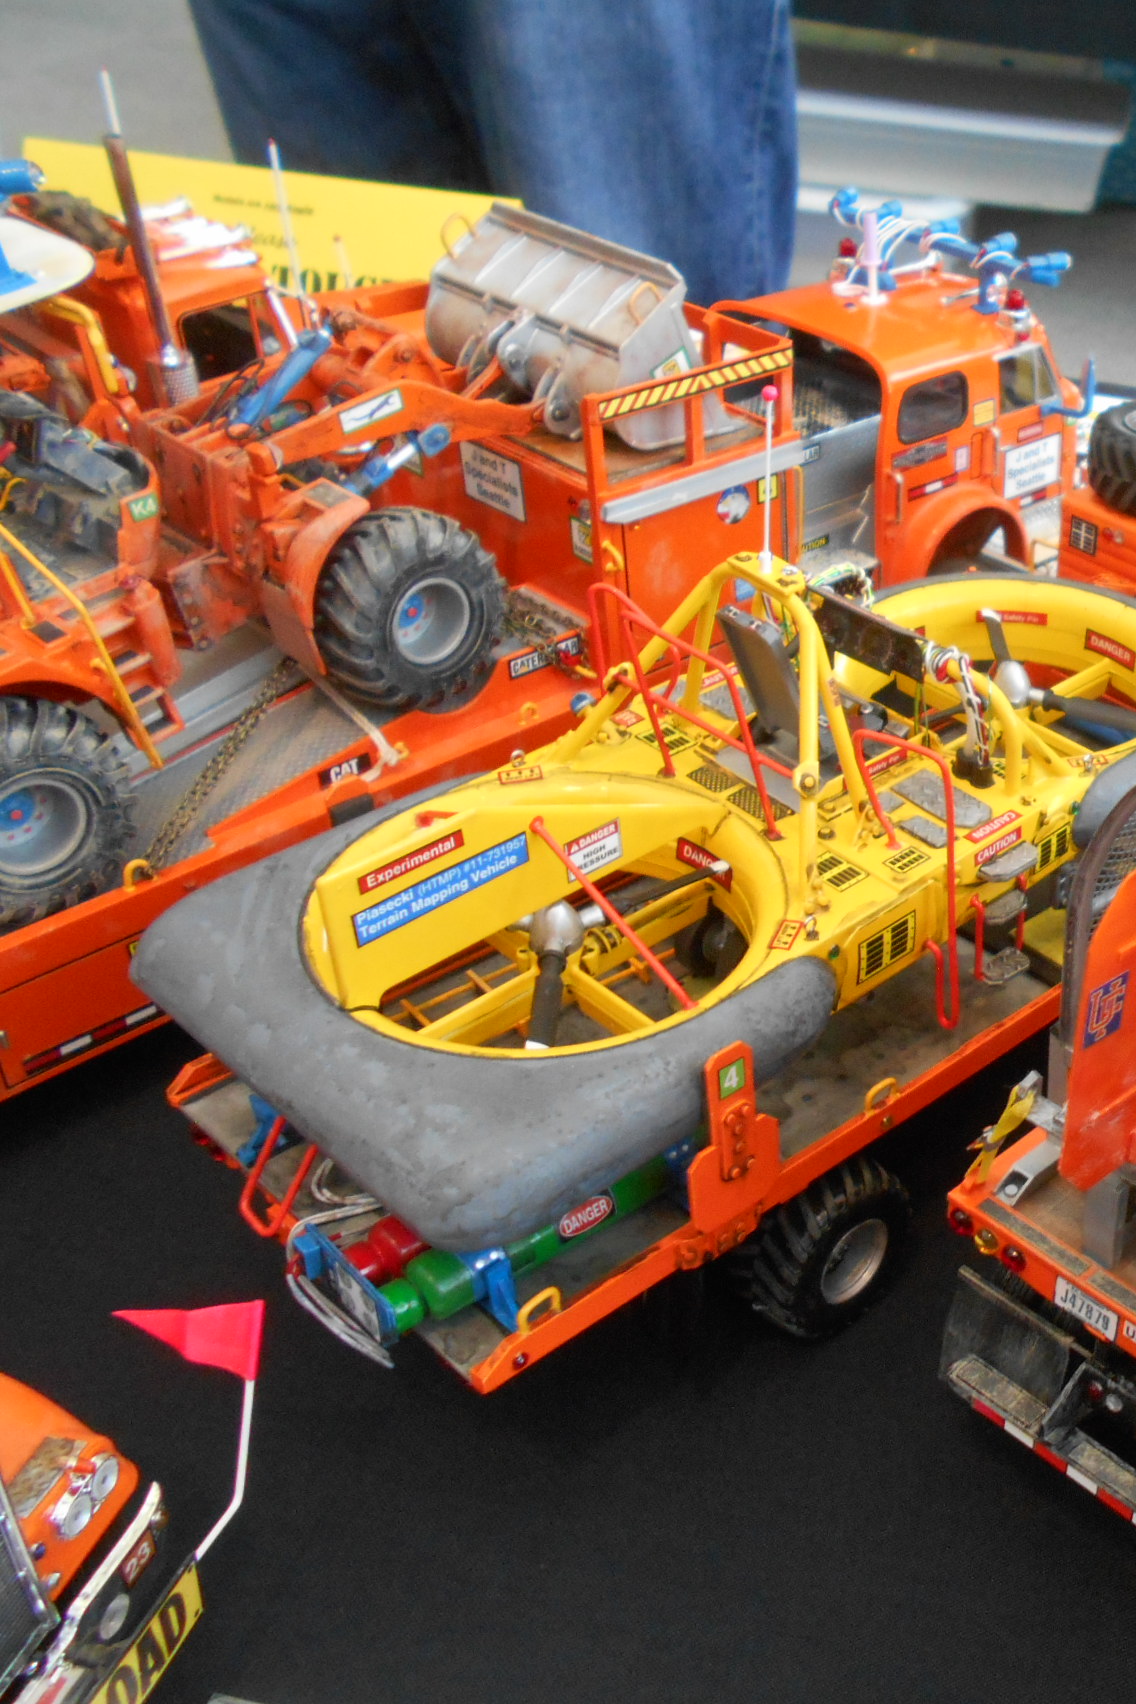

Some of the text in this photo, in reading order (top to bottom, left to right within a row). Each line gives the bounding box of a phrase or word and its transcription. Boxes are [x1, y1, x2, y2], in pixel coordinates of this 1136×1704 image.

[131, 498, 157, 515] K4
[1090, 635, 1132, 663] DANGER
[330, 758, 360, 784] CAT
[579, 823, 617, 847] DANGER
[972, 812, 1017, 839] CAUTION
[366, 836, 456, 888] Experimental
[576, 846, 620, 871] RESSURE
[583, 844, 607, 861] HIGH
[976, 831, 1018, 863] CAUTION
[356, 834, 526, 924] Piasecki (HTMP) #11-731957
[360, 854, 518, 938] Terrain Mapping Vehicle
[724, 1065, 739, 1088] 4
[563, 1199, 608, 1233] DANGER
[1060, 1288, 1110, 1332] J47879
[126, 1541, 151, 1580] 23
[106, 1591, 188, 1704] OAD
